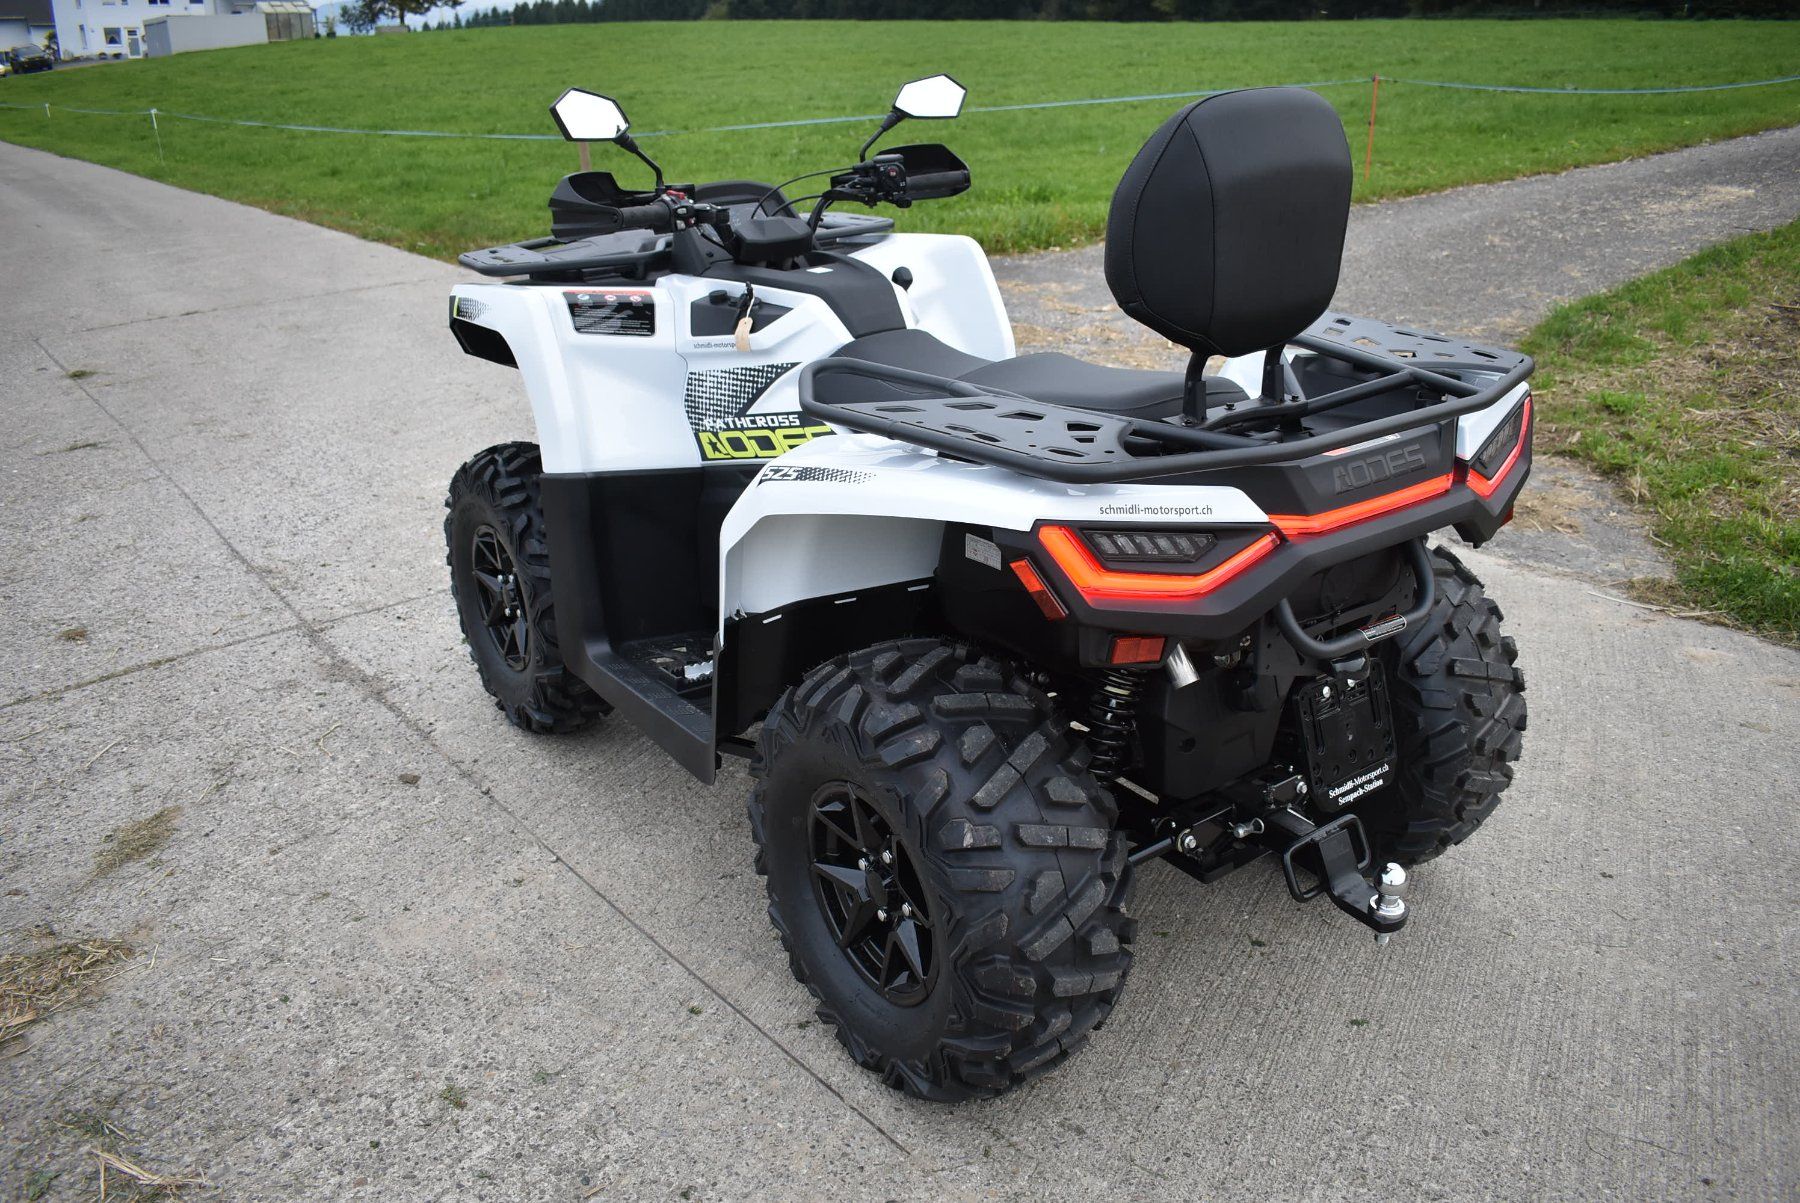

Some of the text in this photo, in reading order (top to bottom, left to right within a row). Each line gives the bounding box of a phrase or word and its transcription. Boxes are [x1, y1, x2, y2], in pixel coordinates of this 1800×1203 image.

[704, 414, 800, 431] PATHCROSS
[763, 467, 804, 481] 525
[1333, 443, 1426, 495] AODES
[1099, 504, 1213, 517] schmidli-motorsport.ch
[1328, 763, 1389, 798] Schmidli-Motorsport.ch
[1338, 779, 1384, 806] Sempach-Station
